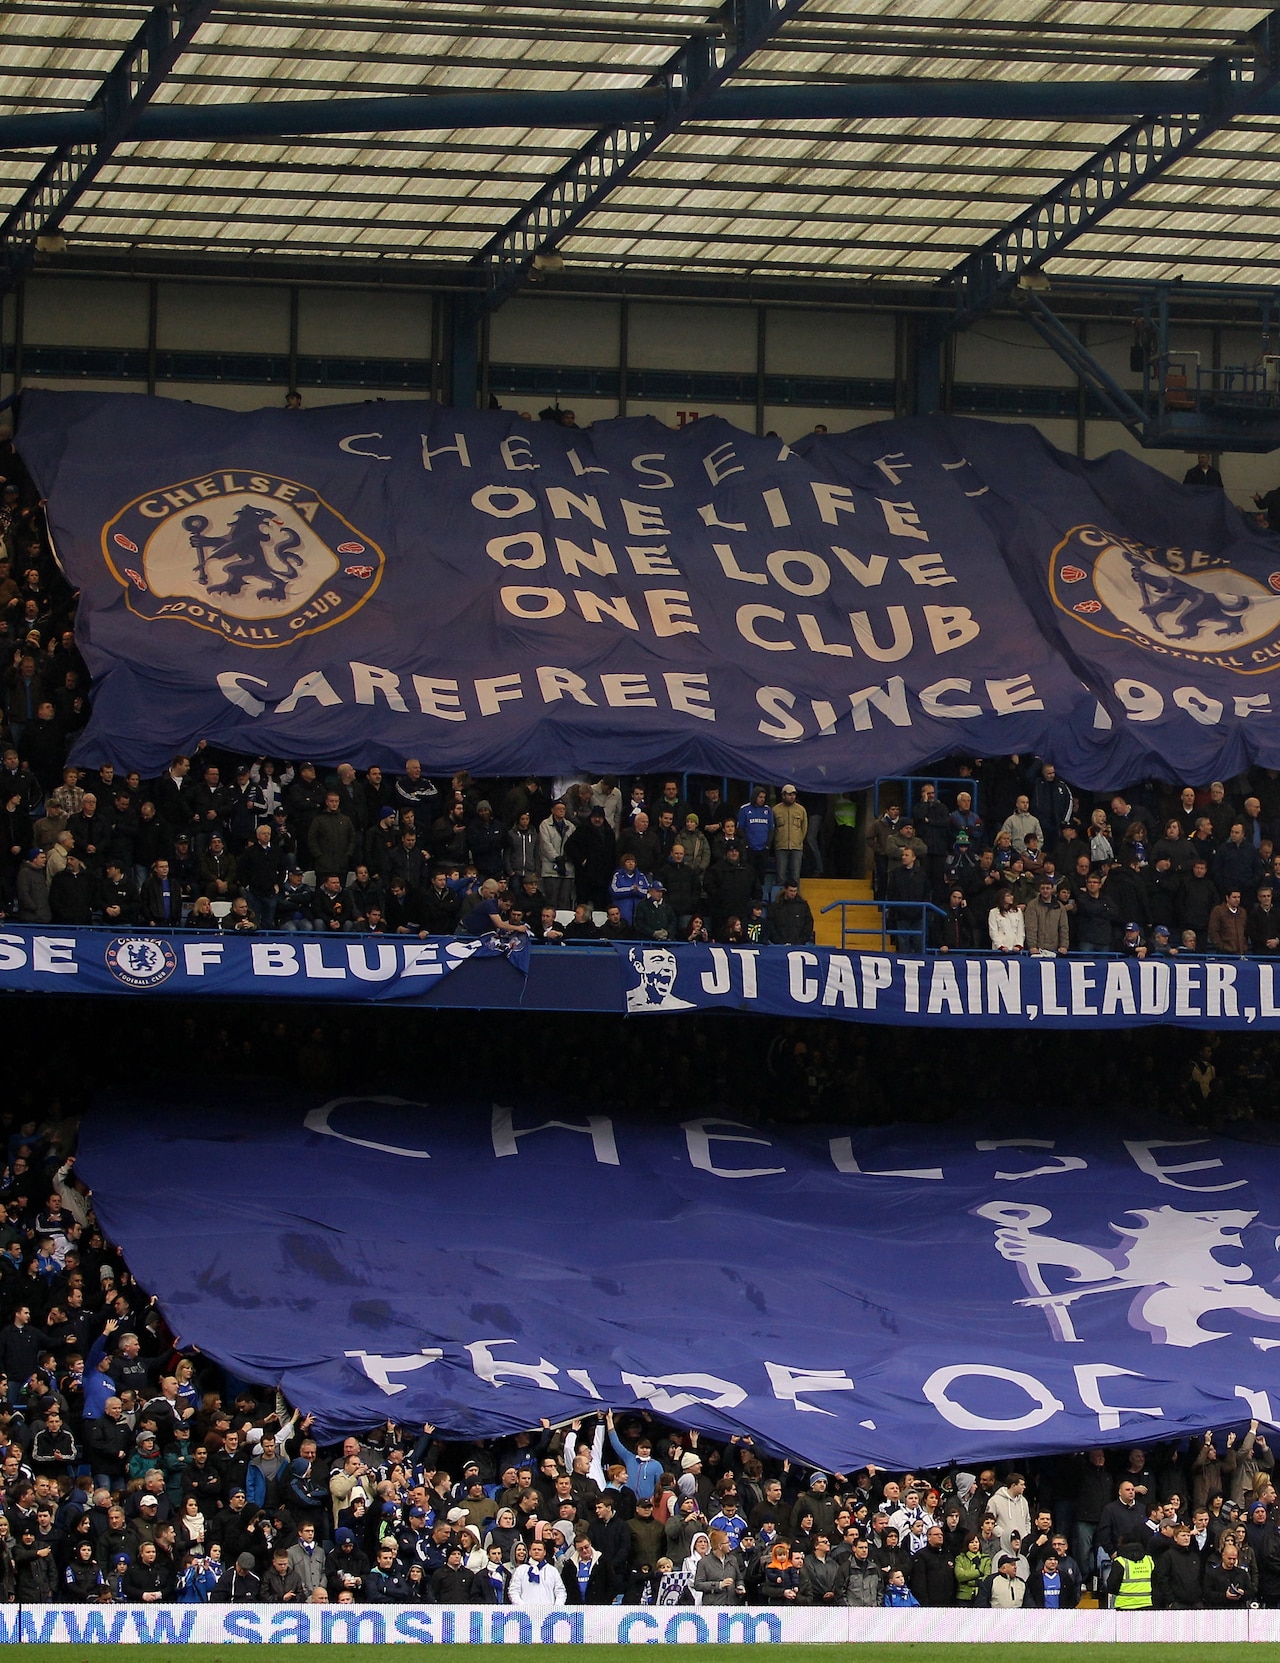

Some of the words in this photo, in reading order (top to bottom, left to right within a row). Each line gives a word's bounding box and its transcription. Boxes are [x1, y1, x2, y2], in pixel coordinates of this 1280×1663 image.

[139, 474, 320, 523] CHELSEA
[471, 485, 672, 538] ONE
[697, 481, 929, 542] LIFE
[486, 531, 681, 578] ONE
[712, 544, 957, 596] LOVE
[156, 601, 279, 640] FOOTBALL
[288, 590, 342, 630] CLUB
[500, 585, 699, 637] ONE
[735, 603, 980, 662] CLUB
[1120, 626, 1243, 667] FOOTBALL
[216, 661, 716, 721] CAREFREE
[756, 673, 1043, 742] SINCE
[749, 817, 768, 825] SAMSUNG
[183, 942, 222, 977] F
[700, 947, 761, 998] JT
[922, 1363, 1164, 1432] OF
